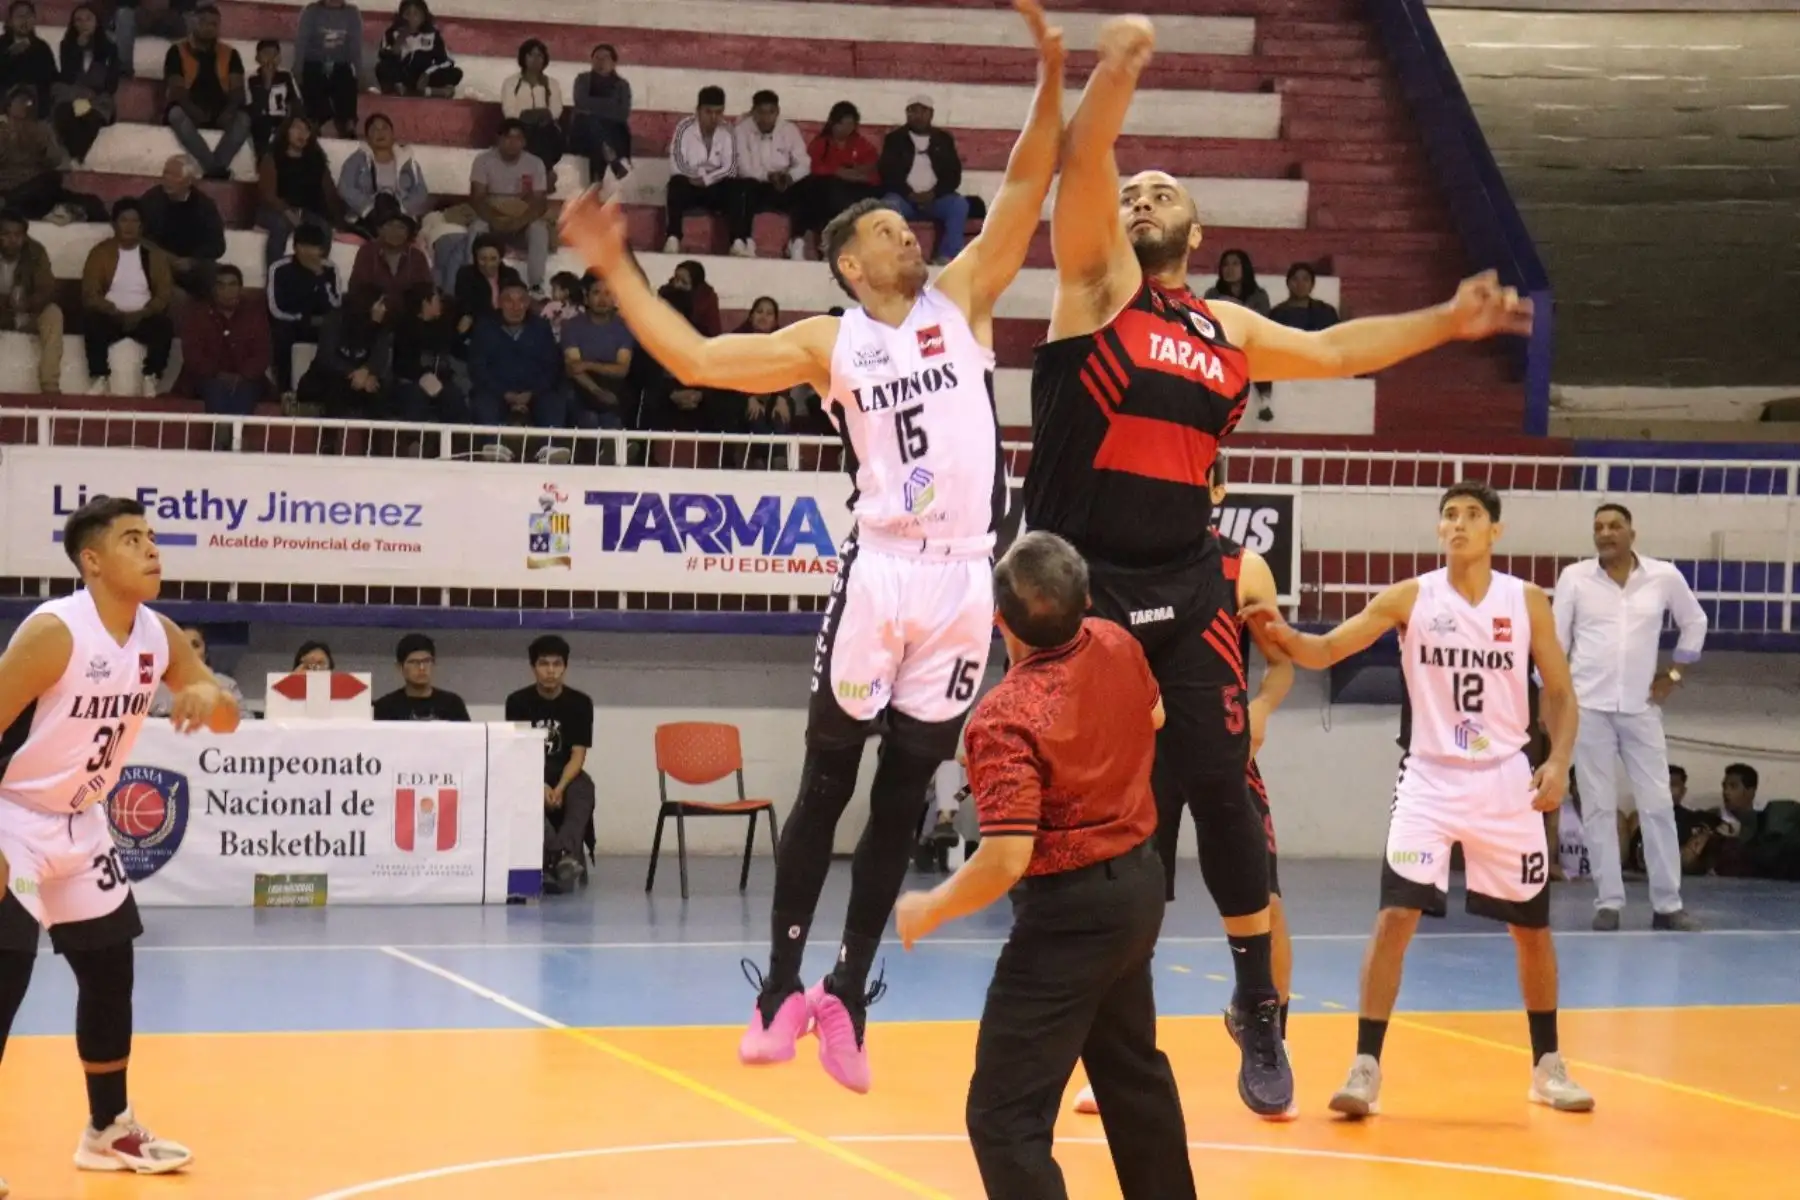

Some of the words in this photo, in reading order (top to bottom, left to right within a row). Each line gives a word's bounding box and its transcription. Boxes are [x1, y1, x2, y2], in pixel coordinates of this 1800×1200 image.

[1149, 333, 1225, 383] TARMA
[851, 362, 958, 413] LATINOS
[895, 404, 929, 464] 15
[136, 487, 248, 531] Fathy
[257, 491, 423, 528] Jimenez
[585, 490, 837, 557] TARMA
[209, 534, 269, 550] Alcalde
[273, 536, 348, 552] Provincial
[351, 540, 371, 553] de
[374, 541, 422, 553] Tarma
[1130, 606, 1175, 625] TARMA
[1420, 645, 1514, 671] LATINOS
[945, 657, 980, 701] 15
[1453, 672, 1484, 713] 12
[1222, 685, 1245, 735] 5
[199, 747, 382, 783] Campeonato
[205, 789, 332, 816] Nacional
[341, 790, 375, 816] de
[219, 829, 368, 857] Basketball
[1520, 852, 1545, 884] 12
